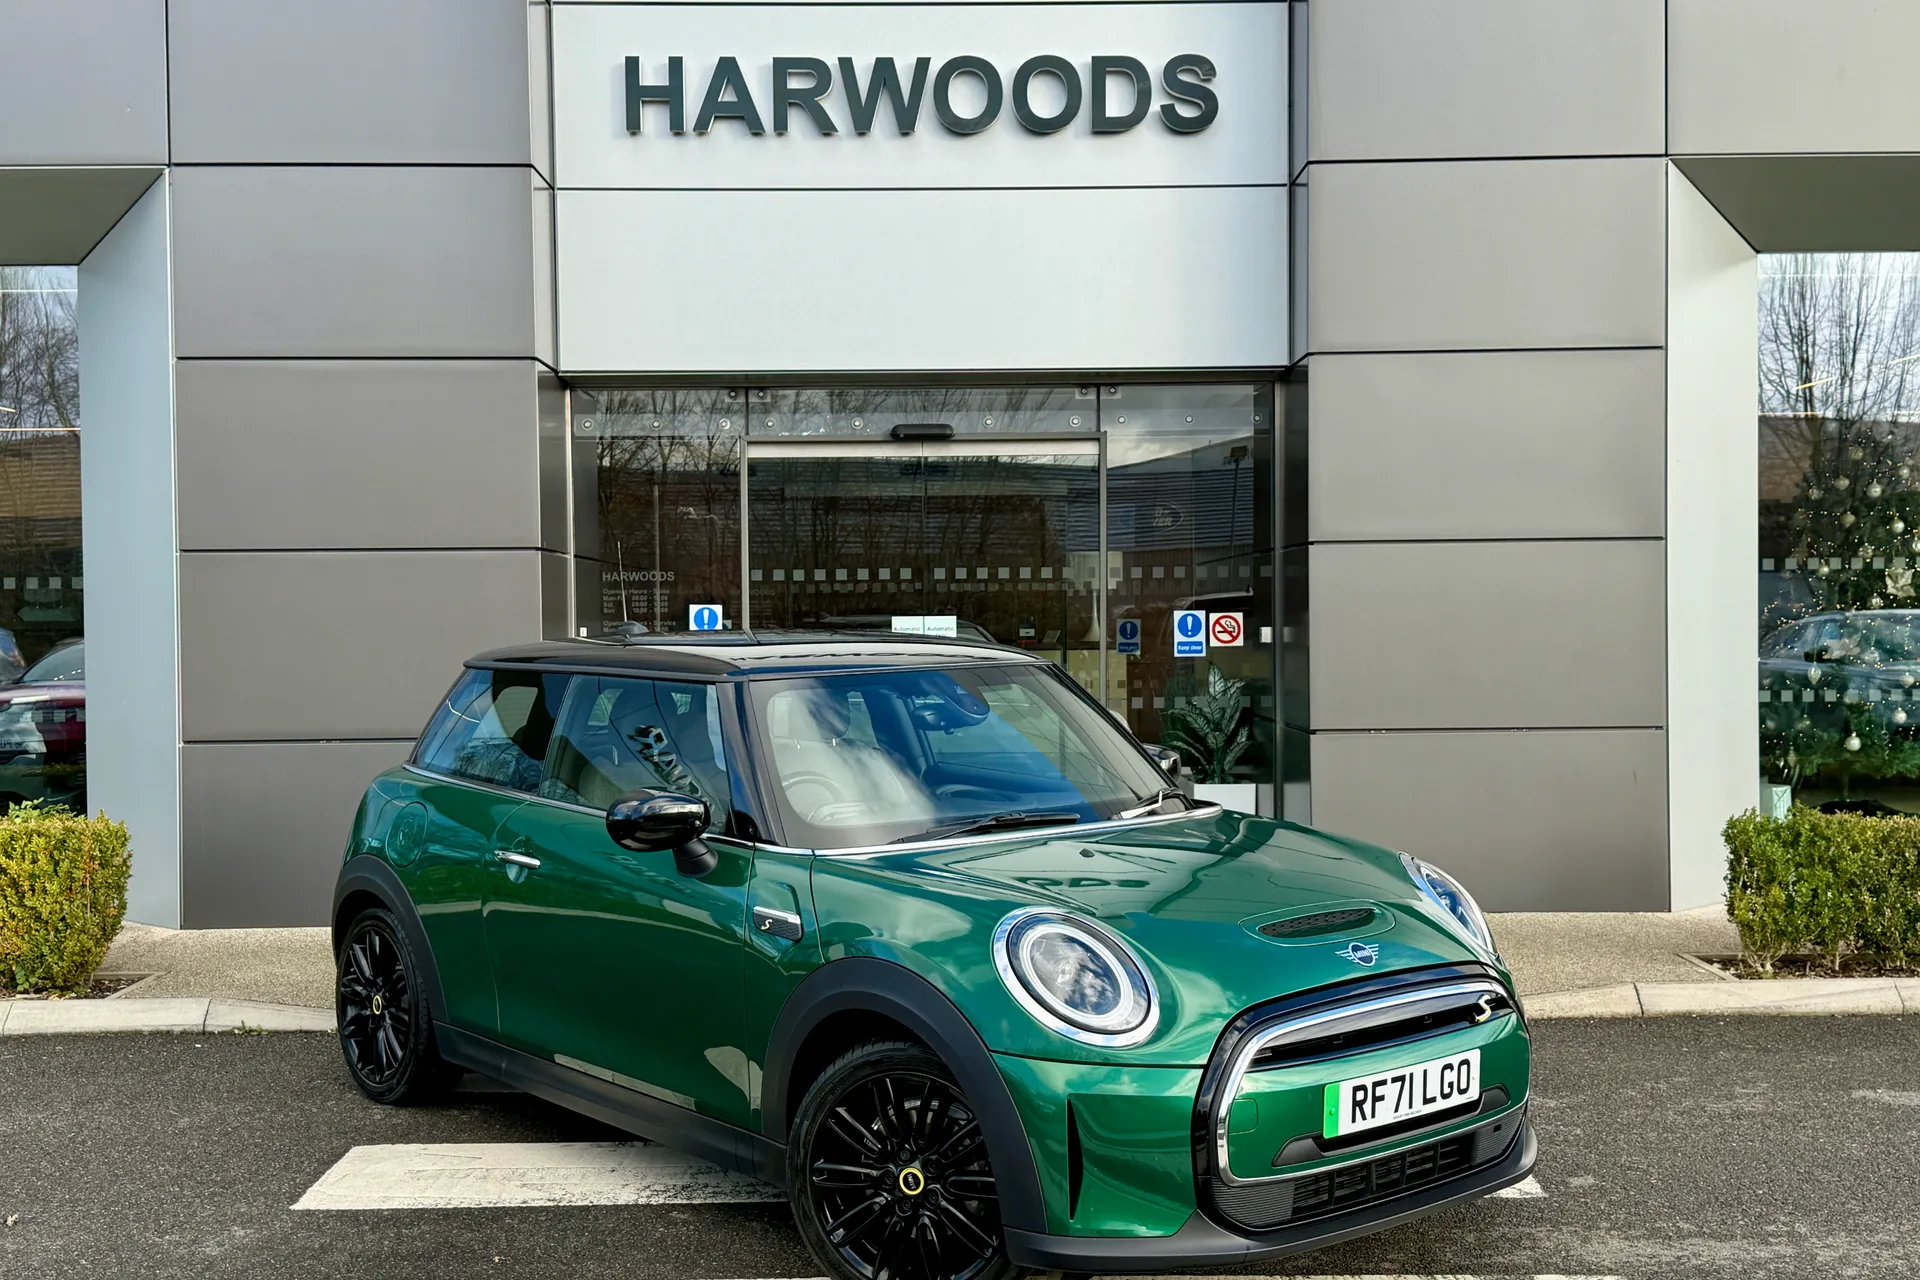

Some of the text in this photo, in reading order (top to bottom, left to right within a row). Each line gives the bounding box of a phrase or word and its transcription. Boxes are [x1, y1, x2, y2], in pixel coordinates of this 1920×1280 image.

[624, 53, 1219, 136] HARWOODS
[602, 571, 675, 582] HARWOODS
[760, 918, 773, 930] S
[1353, 949, 1371, 959] MINI
[1351, 1058, 1471, 1124] RF71 LGO
